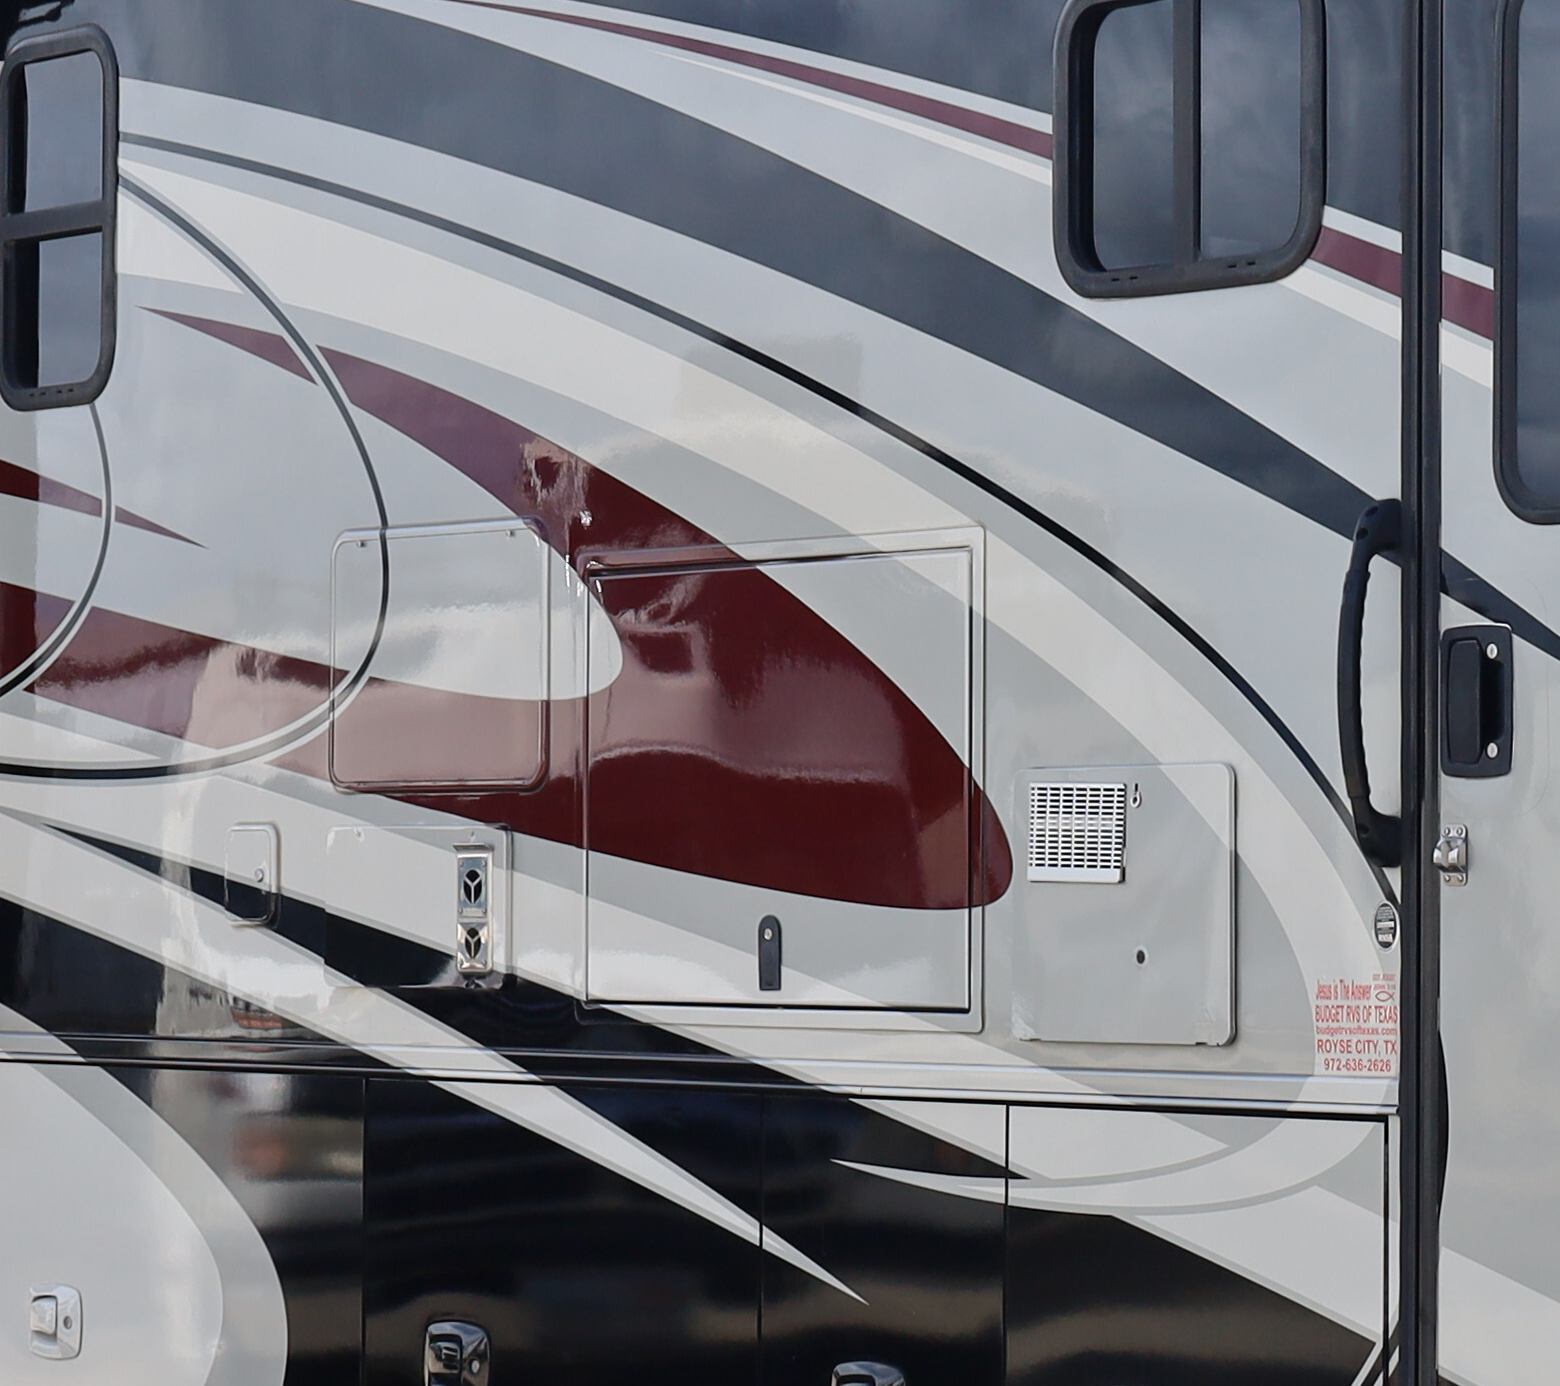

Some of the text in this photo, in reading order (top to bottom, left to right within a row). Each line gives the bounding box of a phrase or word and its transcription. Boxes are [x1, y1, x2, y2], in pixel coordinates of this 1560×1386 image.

[1315, 1005, 1398, 1023] BUDGET RVS OF TEXAS
[1317, 1039, 1397, 1056] ROYSE CITY, TX
[1324, 1058, 1391, 1072] 972-636-2626
